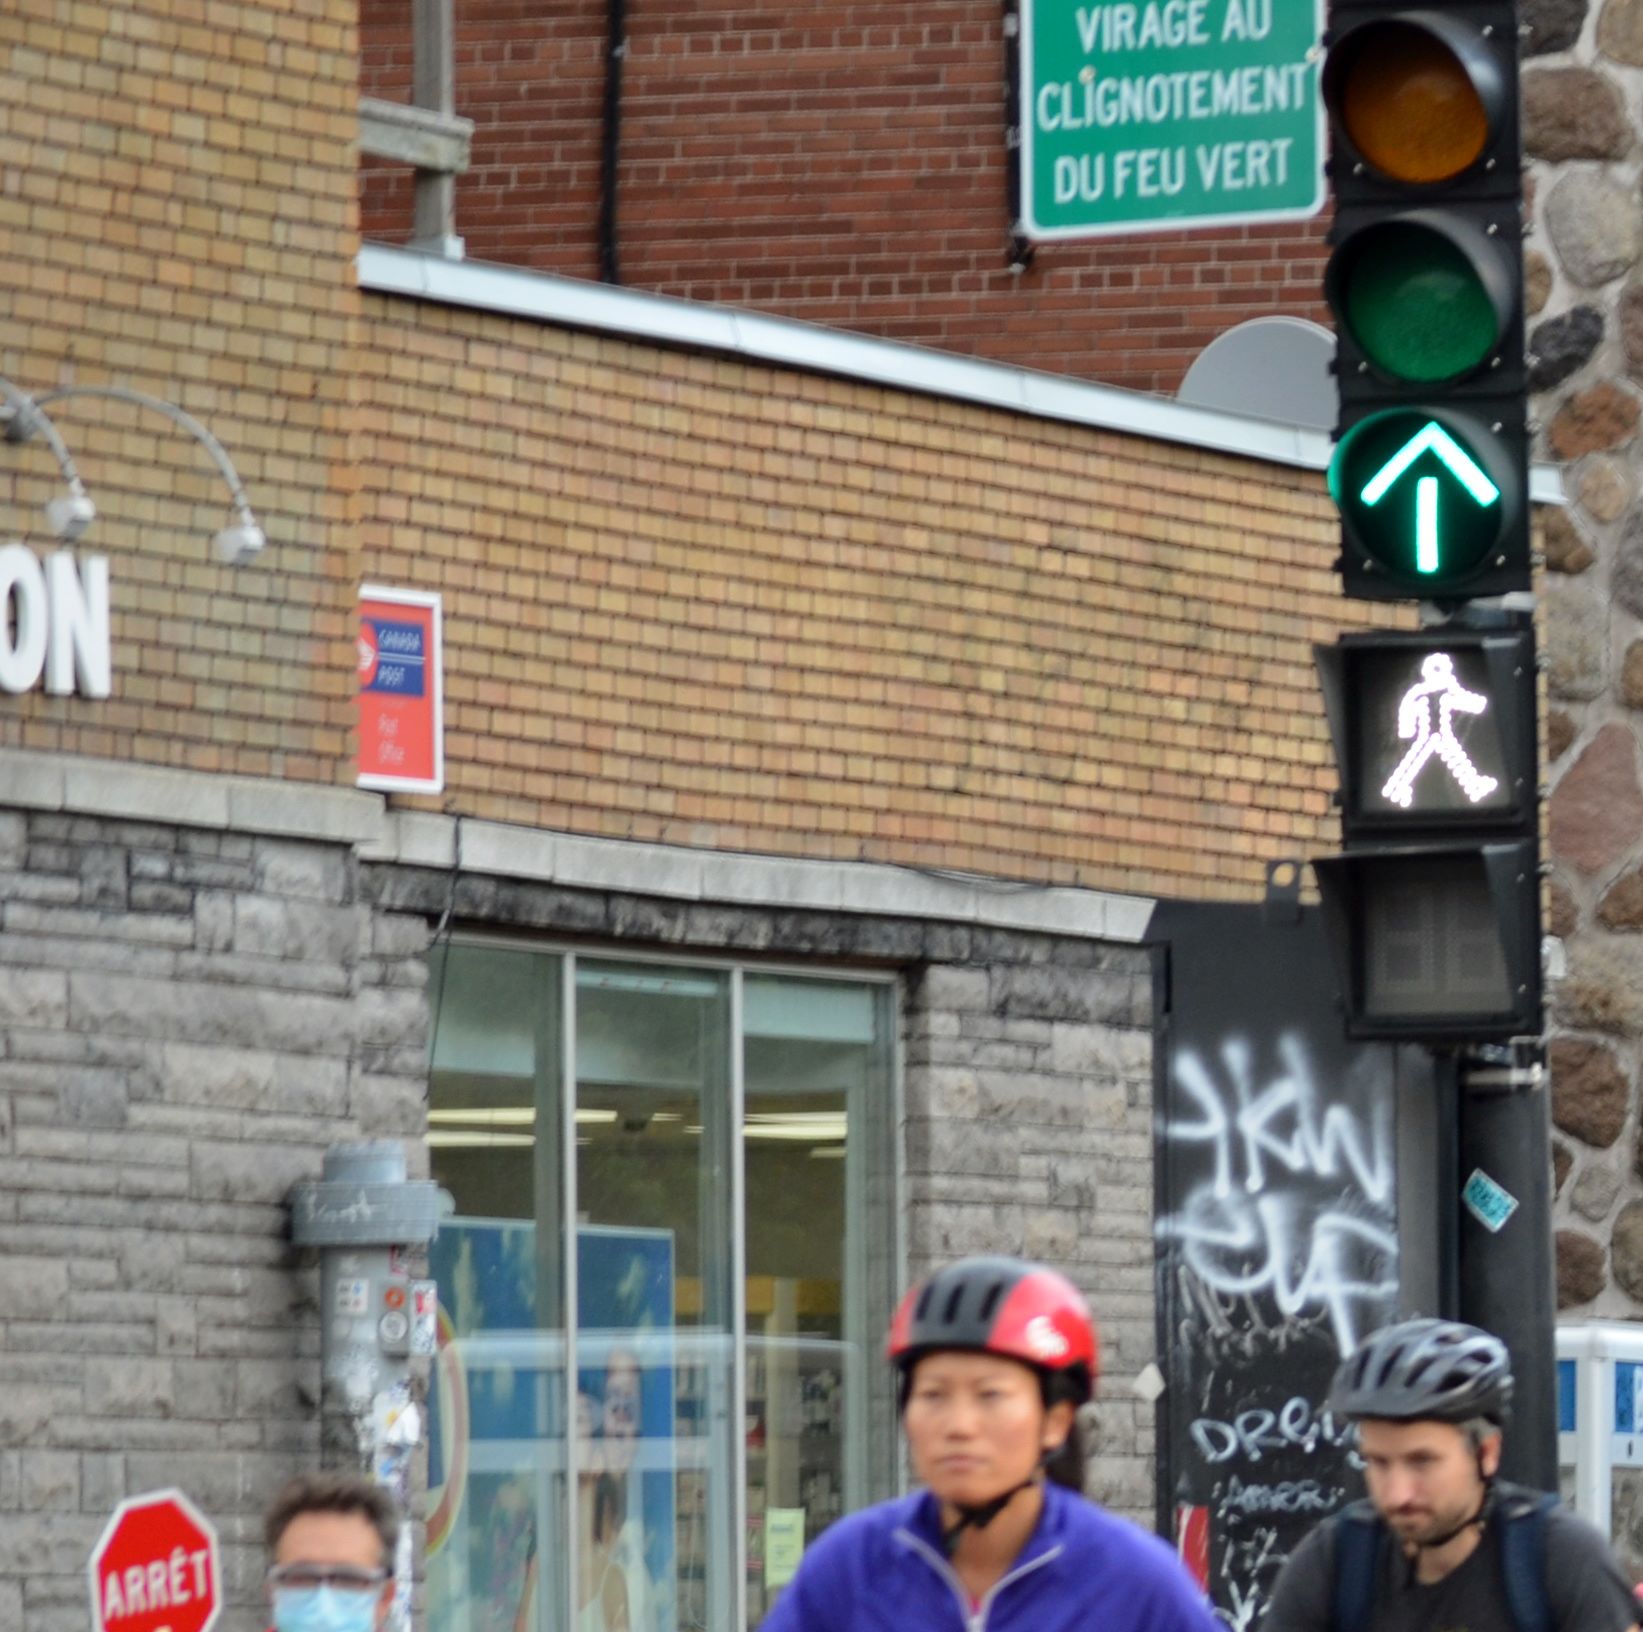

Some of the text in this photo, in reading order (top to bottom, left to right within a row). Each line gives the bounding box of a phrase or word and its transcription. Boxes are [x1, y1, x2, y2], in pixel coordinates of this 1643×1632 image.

[1075, 0, 1273, 54] VIRAGE AU
[1037, 63, 1307, 132] CLIGNOTEMENT
[1054, 138, 1293, 204] DU FEU VERT
[102, 1546, 208, 1620] ARRÊT
